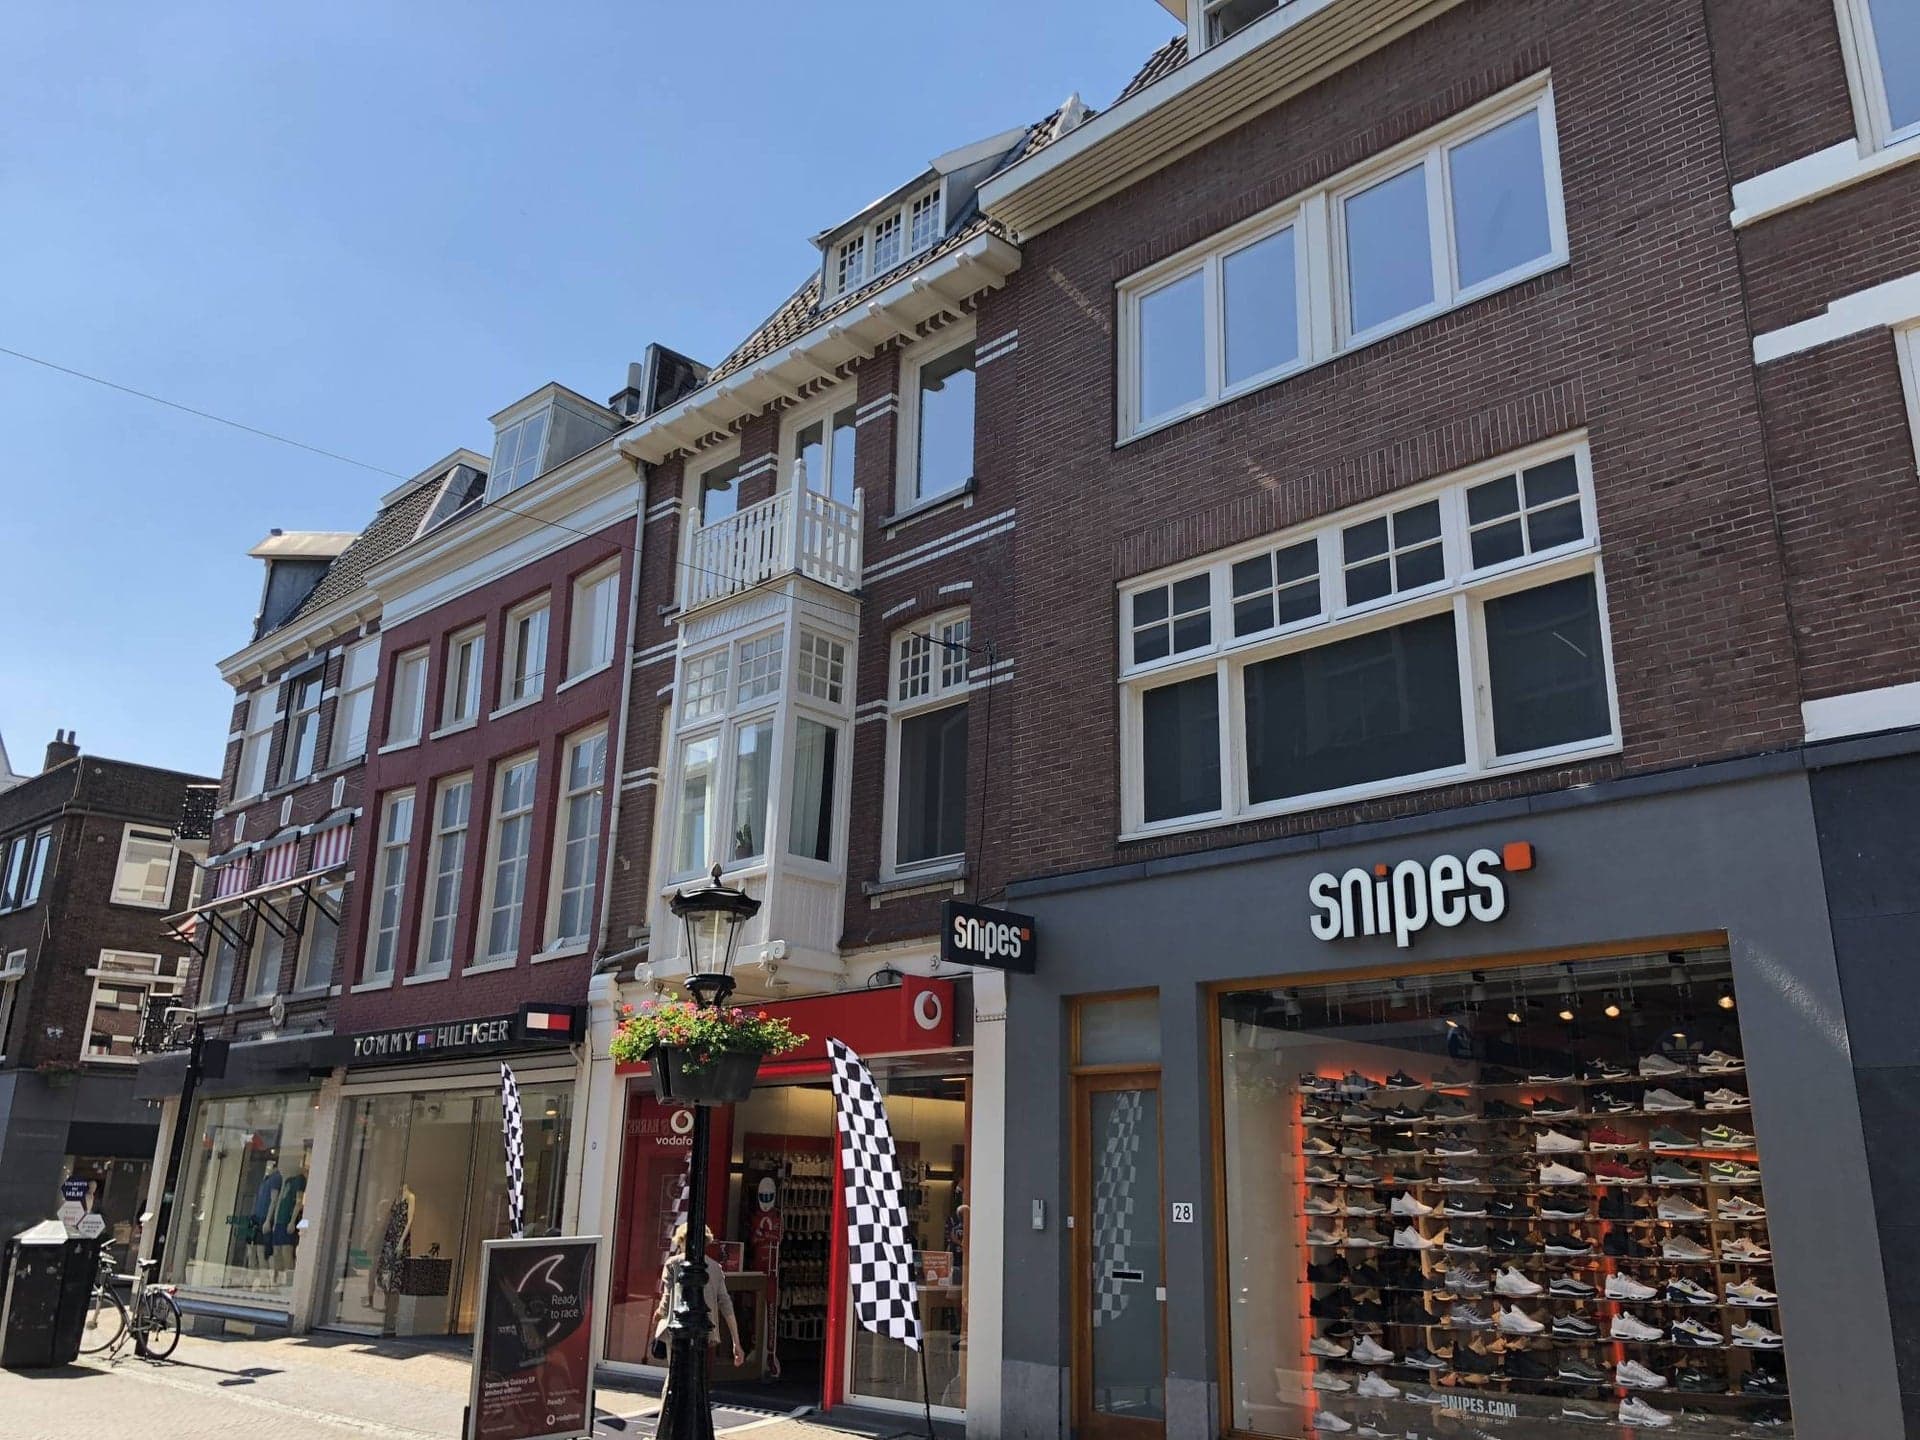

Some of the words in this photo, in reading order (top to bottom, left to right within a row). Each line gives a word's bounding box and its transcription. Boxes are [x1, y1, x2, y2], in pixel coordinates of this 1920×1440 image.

[1309, 848, 1505, 948] snipes
[954, 915, 1021, 960] snipes
[354, 1031, 415, 1056] TOMMY
[437, 1020, 509, 1048] HILFIGER
[1175, 1205, 1191, 1220] 28
[551, 1294, 577, 1306] Ready
[550, 1310, 559, 1319] to
[561, 1309, 579, 1319] race
[1440, 1394, 1517, 1418] SNIPES.COM
